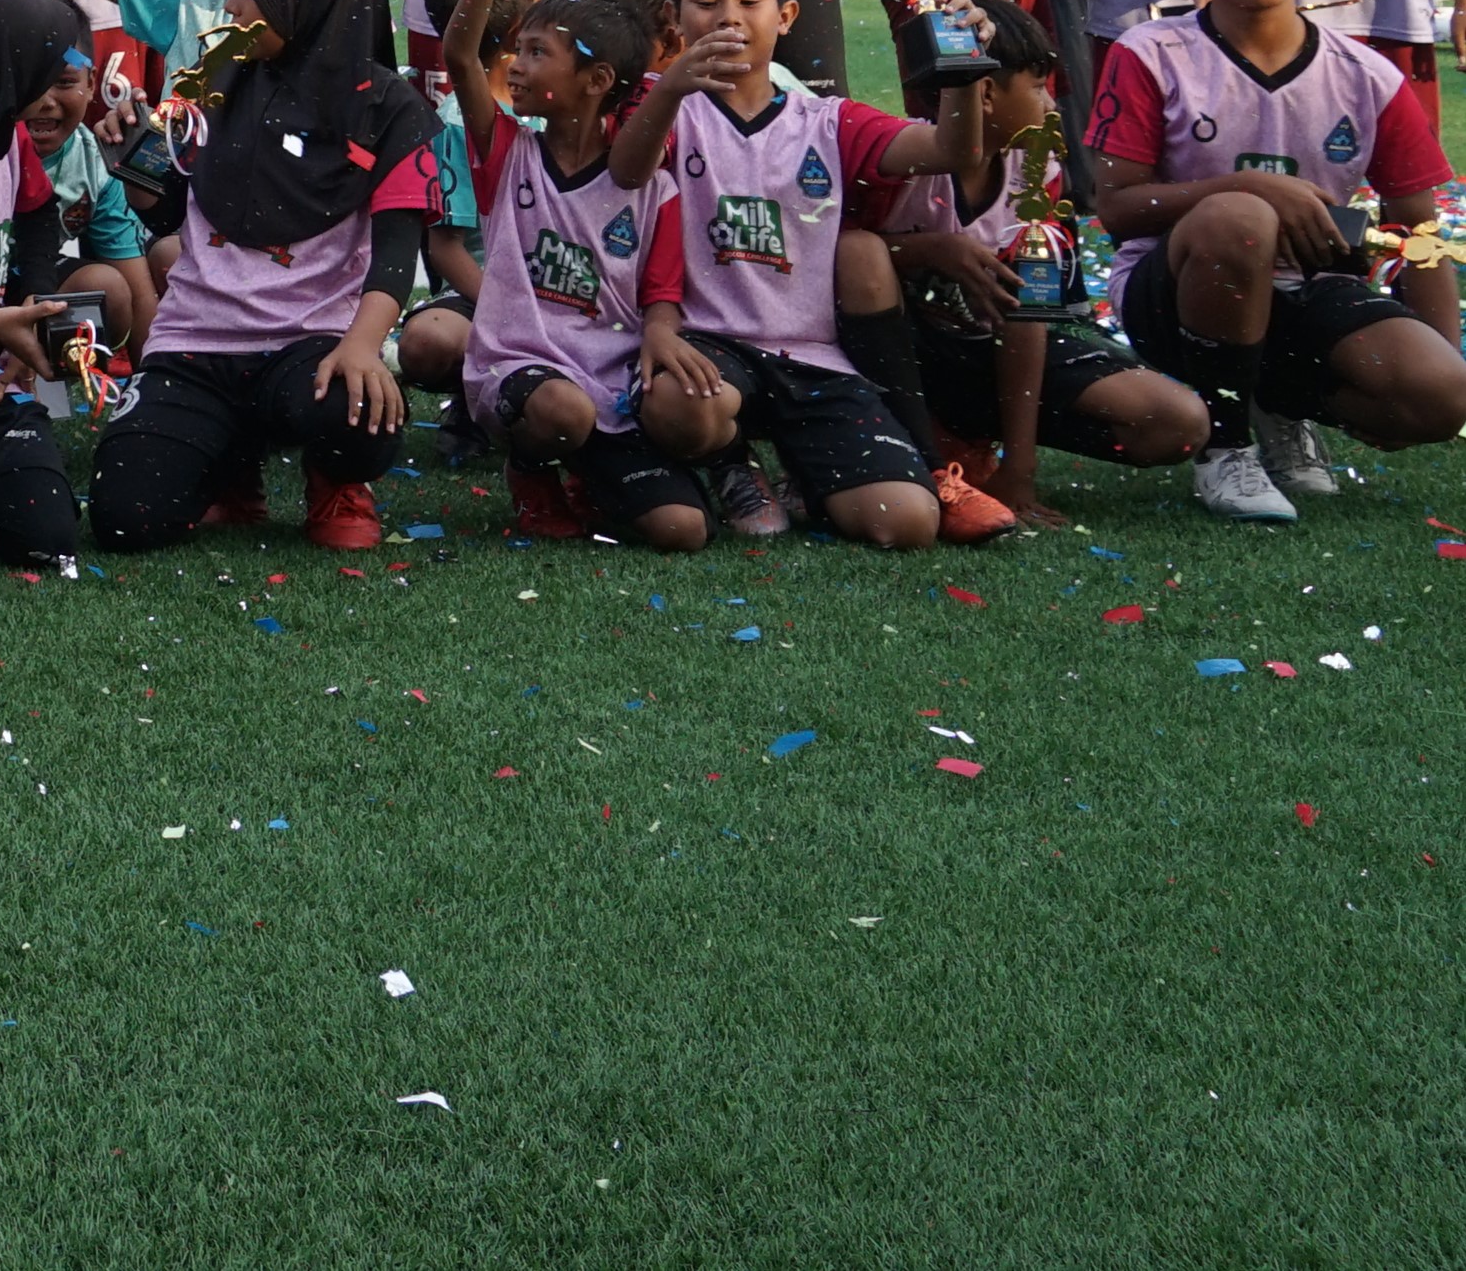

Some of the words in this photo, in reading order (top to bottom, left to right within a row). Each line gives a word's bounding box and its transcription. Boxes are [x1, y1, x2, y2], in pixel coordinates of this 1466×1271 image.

[101, 51, 132, 110] 6
[725, 200, 776, 229] Milk
[733, 226, 783, 255] Life
[544, 271, 596, 299] Life
